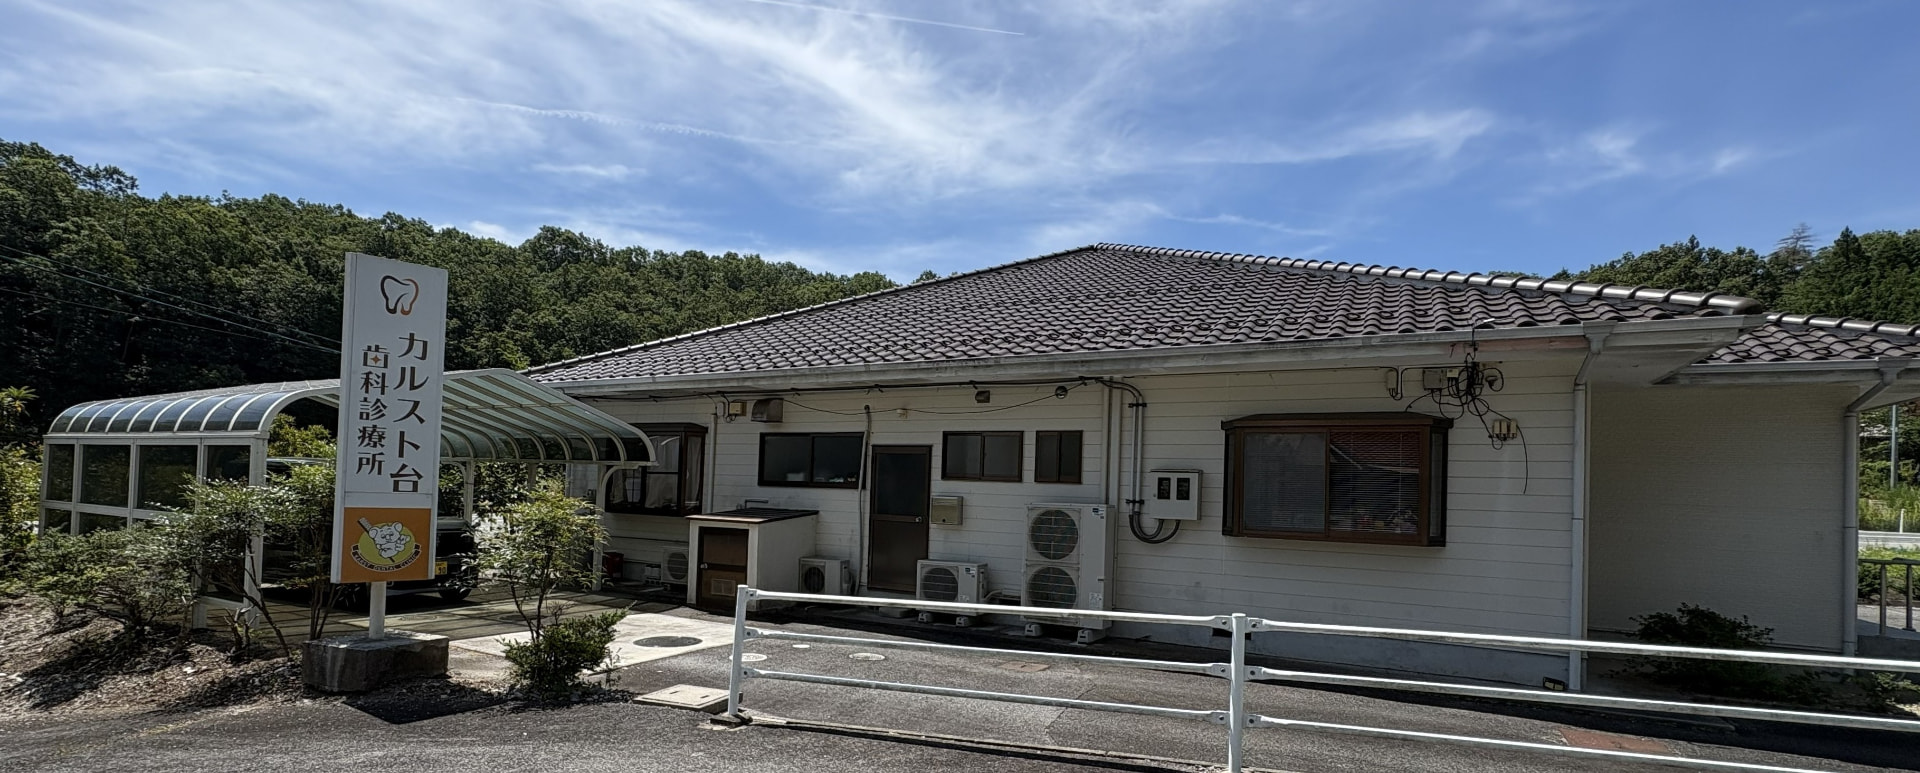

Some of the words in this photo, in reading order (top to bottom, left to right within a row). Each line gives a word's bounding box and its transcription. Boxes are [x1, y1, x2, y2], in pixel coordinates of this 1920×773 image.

[356, 344, 391, 476] 歯科診療所
[389, 332, 430, 493] カルスト台
